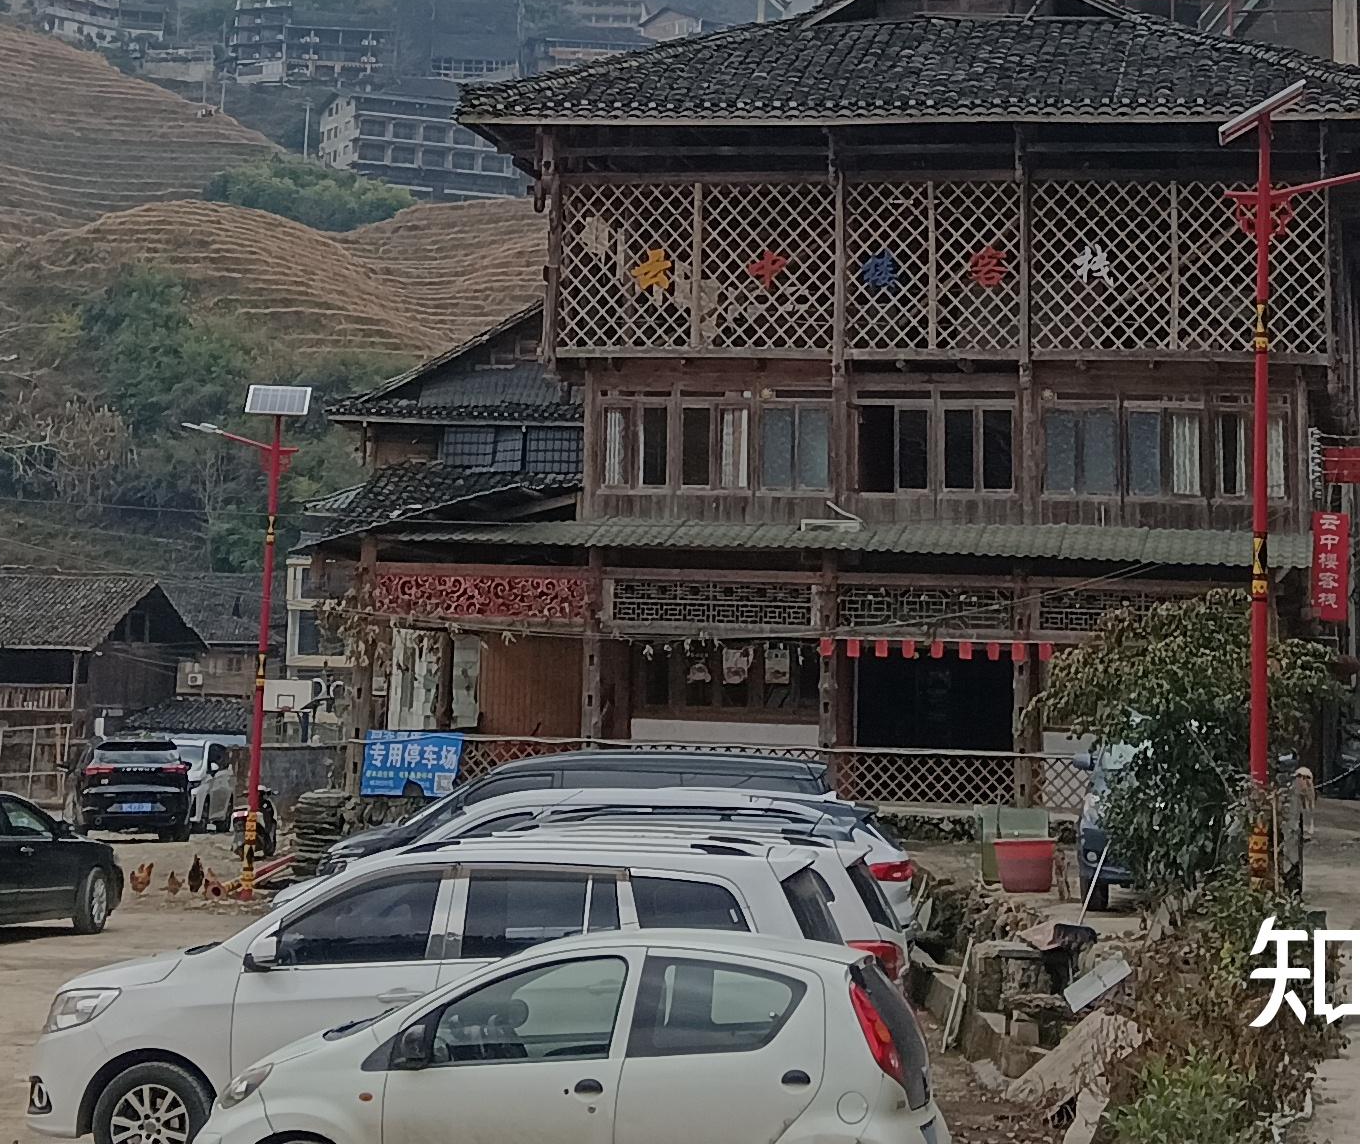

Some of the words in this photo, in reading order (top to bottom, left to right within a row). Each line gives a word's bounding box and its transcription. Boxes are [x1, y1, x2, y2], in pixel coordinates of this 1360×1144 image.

[370, 742, 457, 770] 专用停车场
